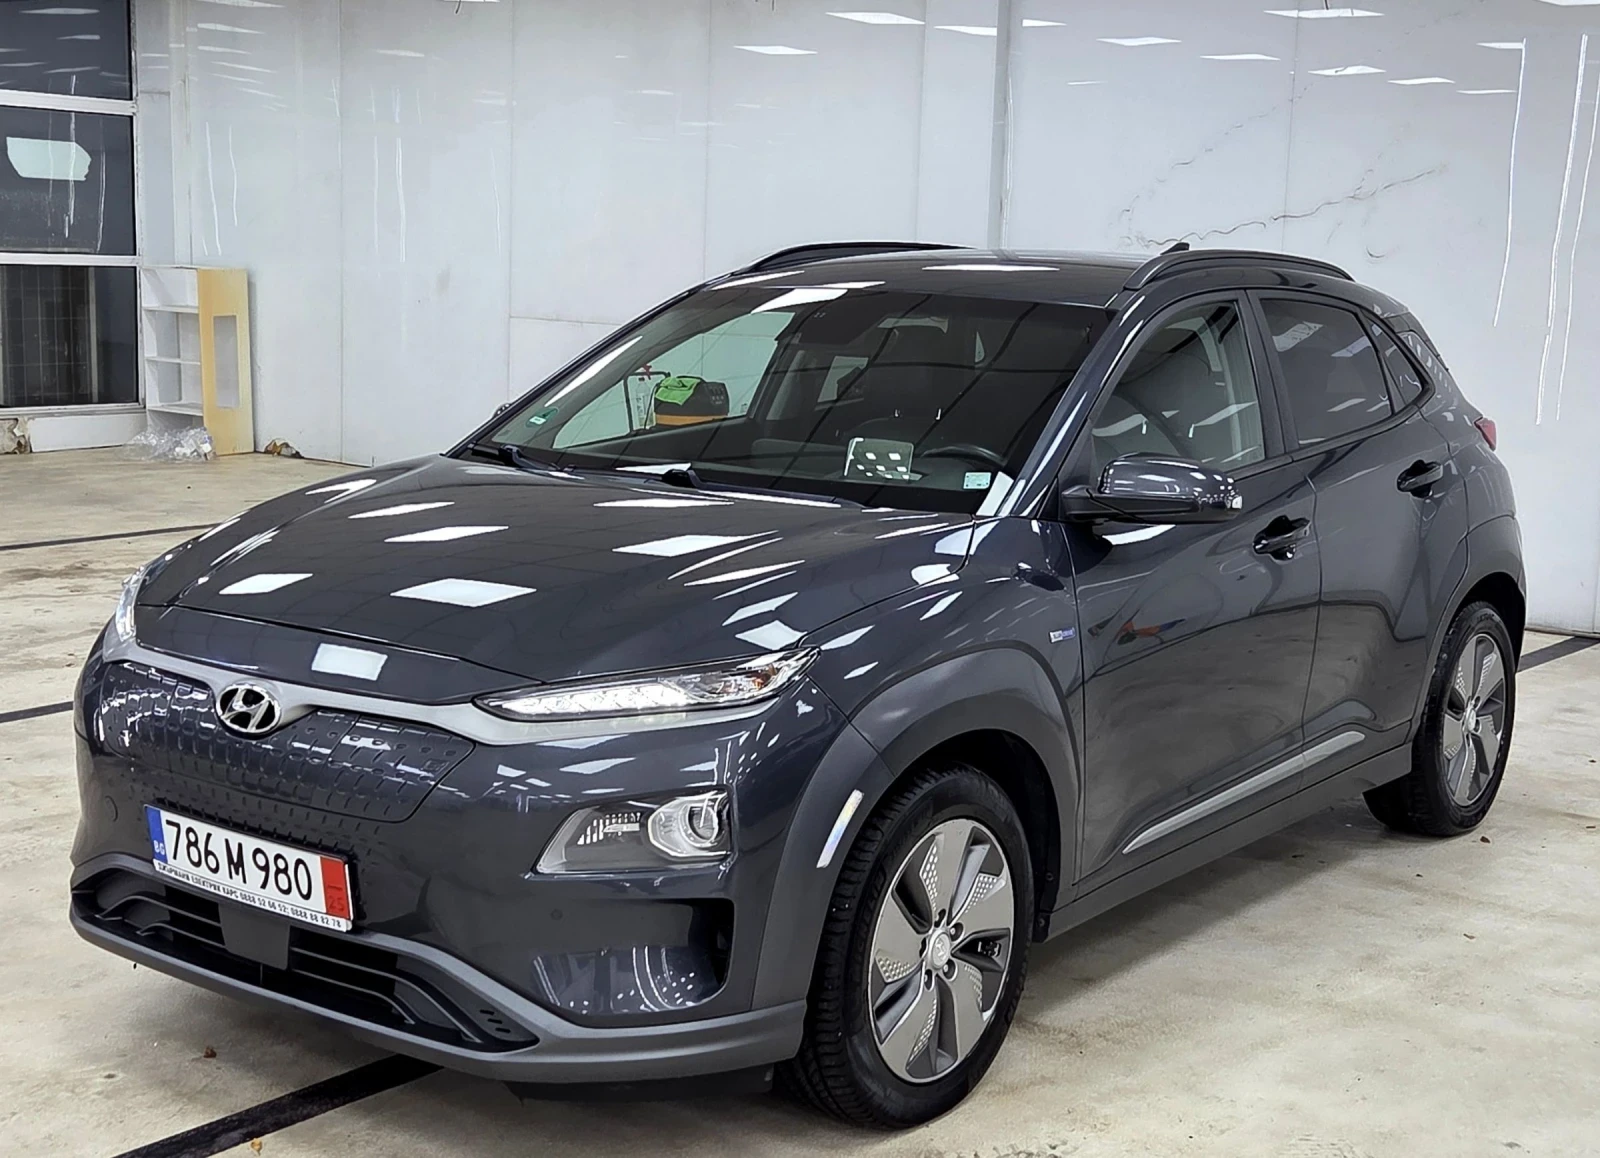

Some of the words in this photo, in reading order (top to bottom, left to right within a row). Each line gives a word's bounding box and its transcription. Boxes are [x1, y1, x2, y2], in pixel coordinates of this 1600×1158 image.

[154, 840, 166, 855] BG
[165, 819, 220, 874] 786
[224, 838, 247, 884] M
[252, 847, 313, 901] 980
